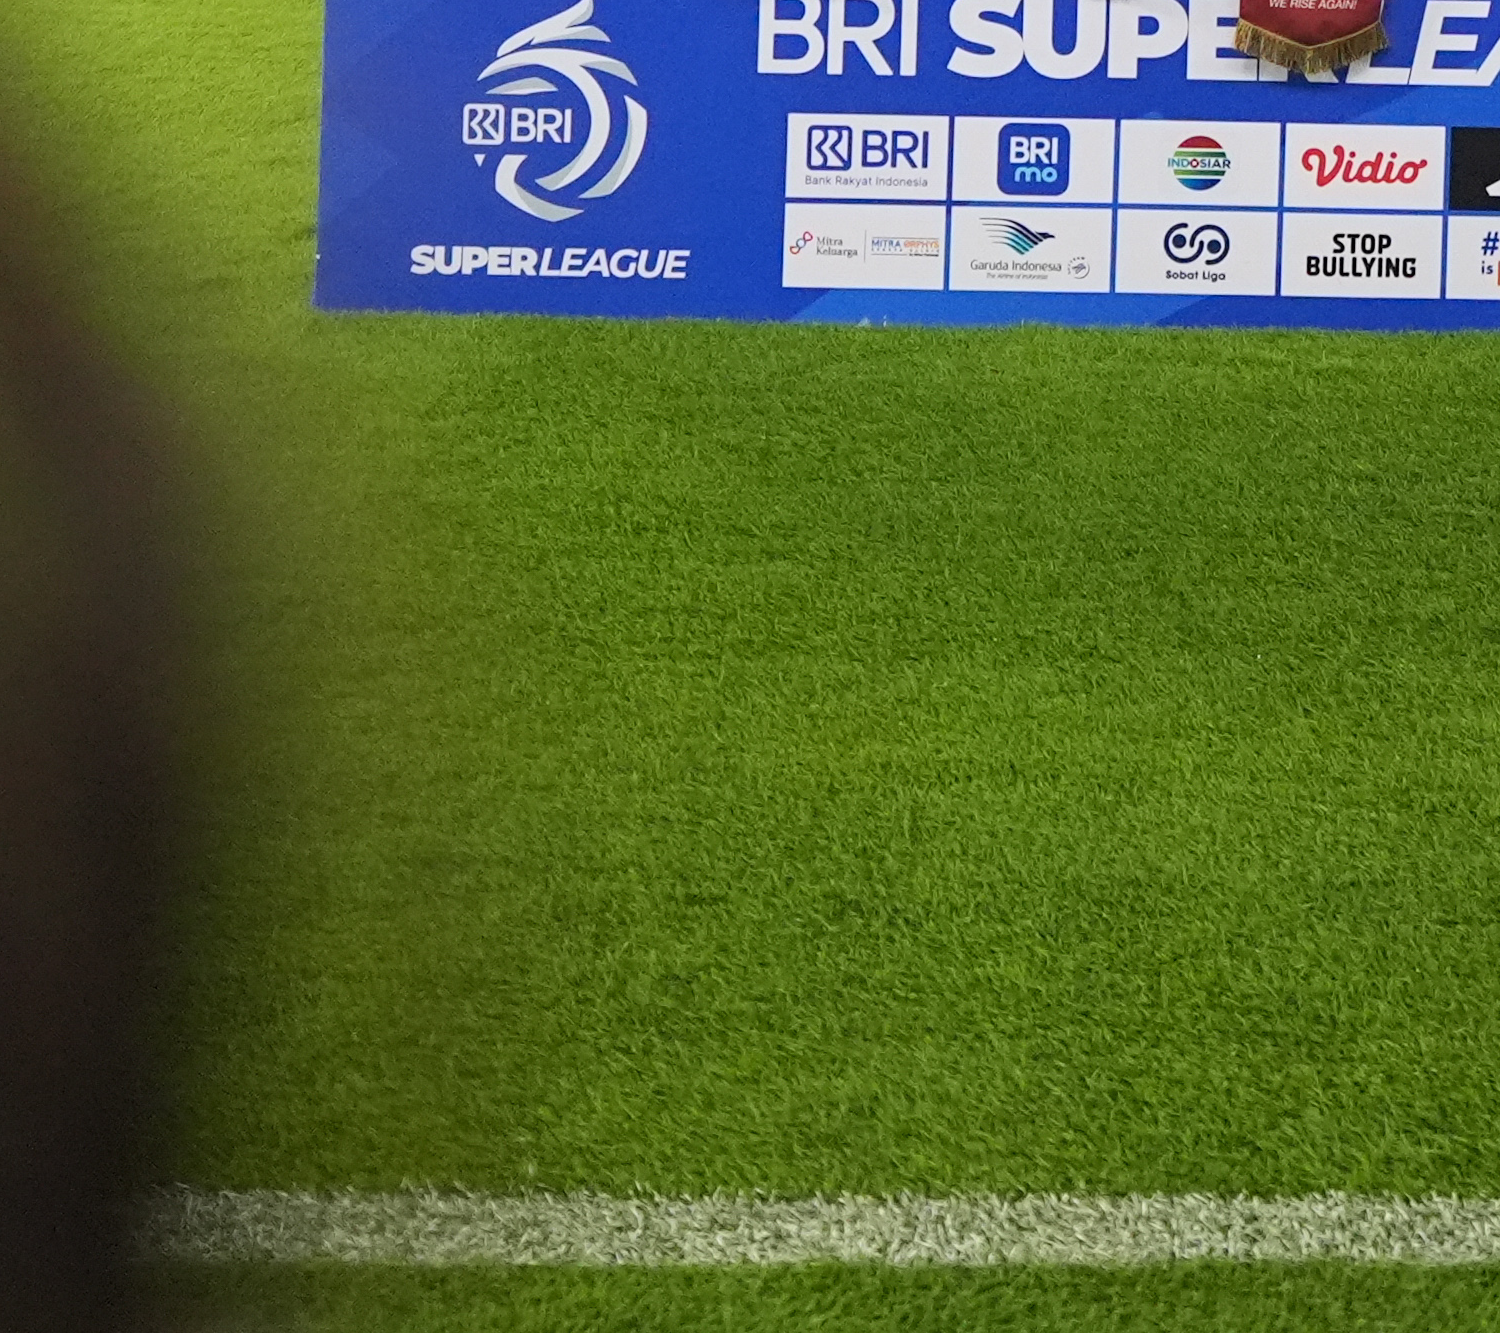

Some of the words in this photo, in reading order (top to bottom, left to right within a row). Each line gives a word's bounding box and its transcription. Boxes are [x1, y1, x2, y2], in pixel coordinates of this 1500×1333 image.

[510, 108, 572, 144] BRI
[861, 129, 930, 169] BRI
[1009, 136, 1059, 165] BRI
[1167, 156, 1231, 170] INDOSIAR
[1301, 144, 1428, 188] Vidio
[804, 175, 832, 186] Bank
[835, 175, 873, 189] Rakyat
[875, 176, 929, 188] Indonesia
[1013, 166, 1058, 183] mo
[816, 236, 843, 247] Mitra
[871, 239, 902, 248] MITRA
[1332, 232, 1392, 254] STOP
[816, 247, 858, 258] Keluarga
[970, 259, 1009, 271] Garuda
[1011, 260, 1062, 272] Indonesia
[1306, 256, 1417, 278] BULLYING
[1480, 260, 1494, 275] is
[1165, 270, 1199, 281] Sobat
[1202, 271, 1226, 282] Liga
